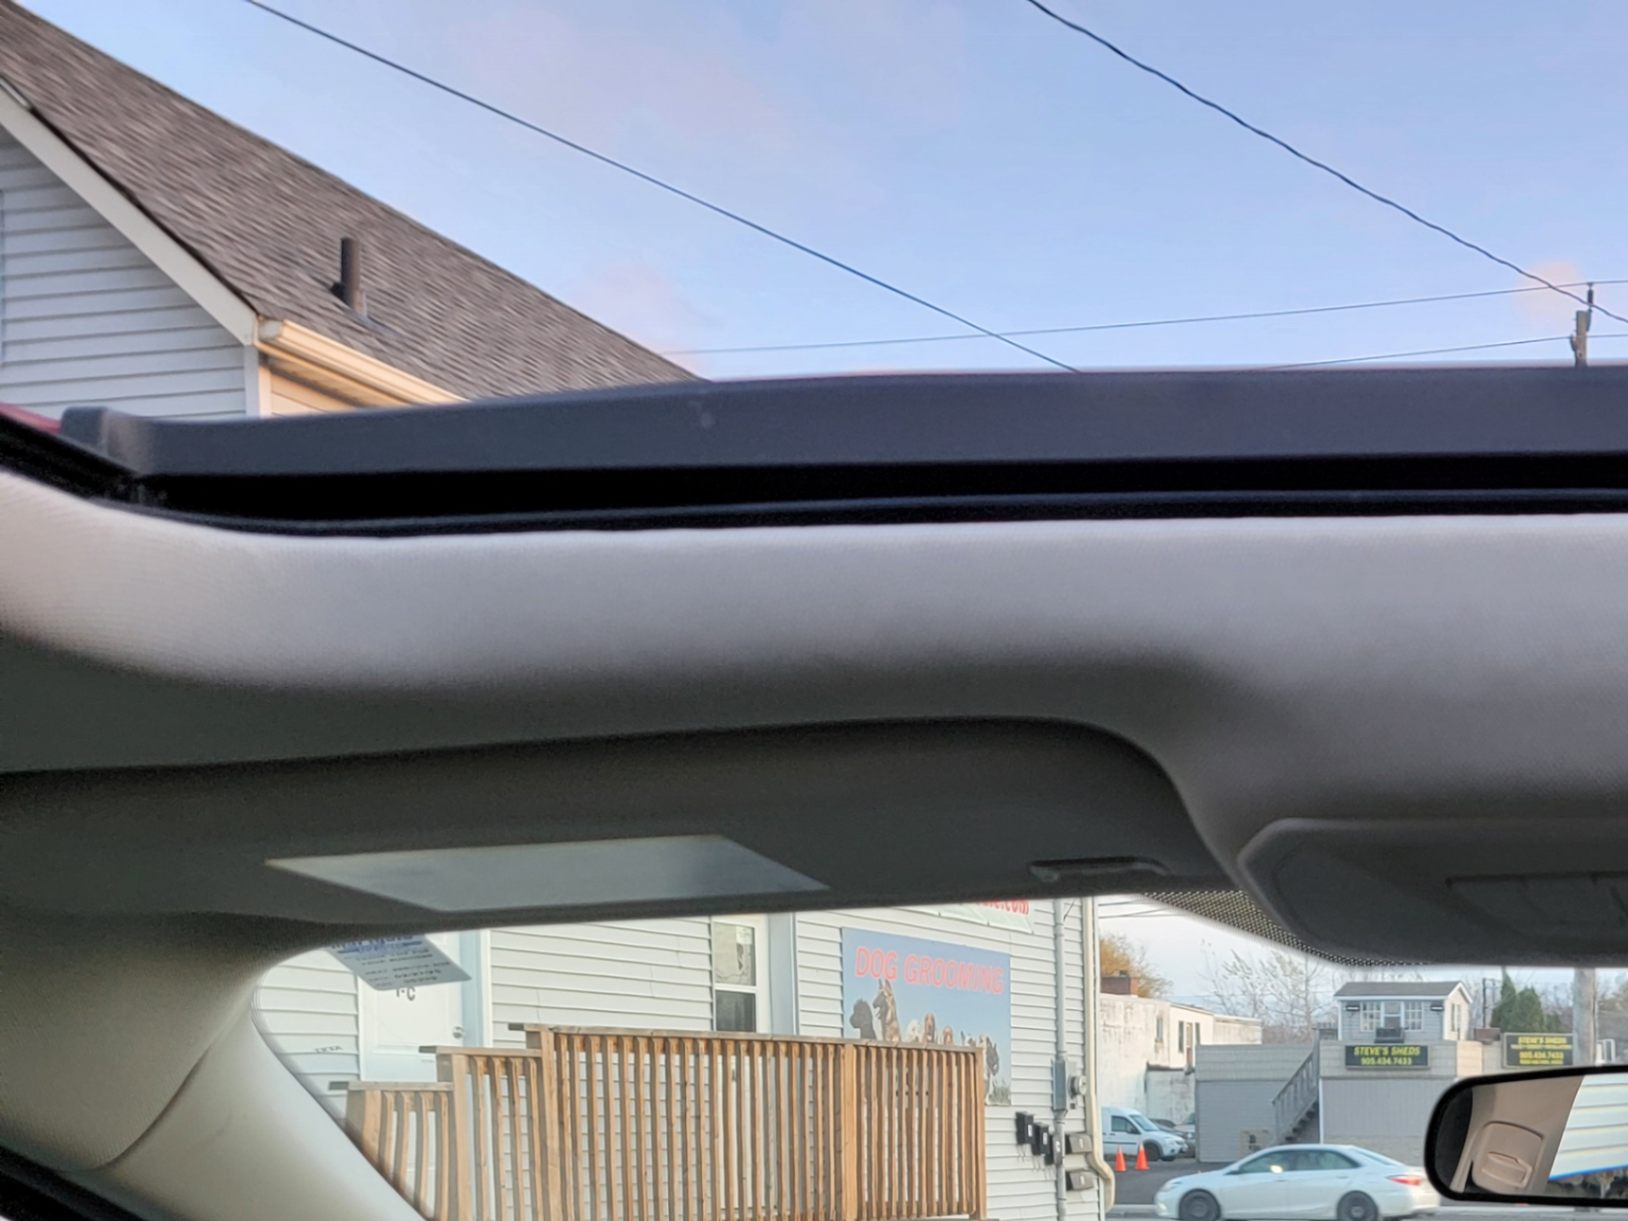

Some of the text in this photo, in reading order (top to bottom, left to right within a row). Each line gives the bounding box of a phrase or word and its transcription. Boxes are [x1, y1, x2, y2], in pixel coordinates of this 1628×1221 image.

[855, 946, 1004, 994] DOG GROOMING
[1353, 1047, 1421, 1056] STEVE'S SHEDS
